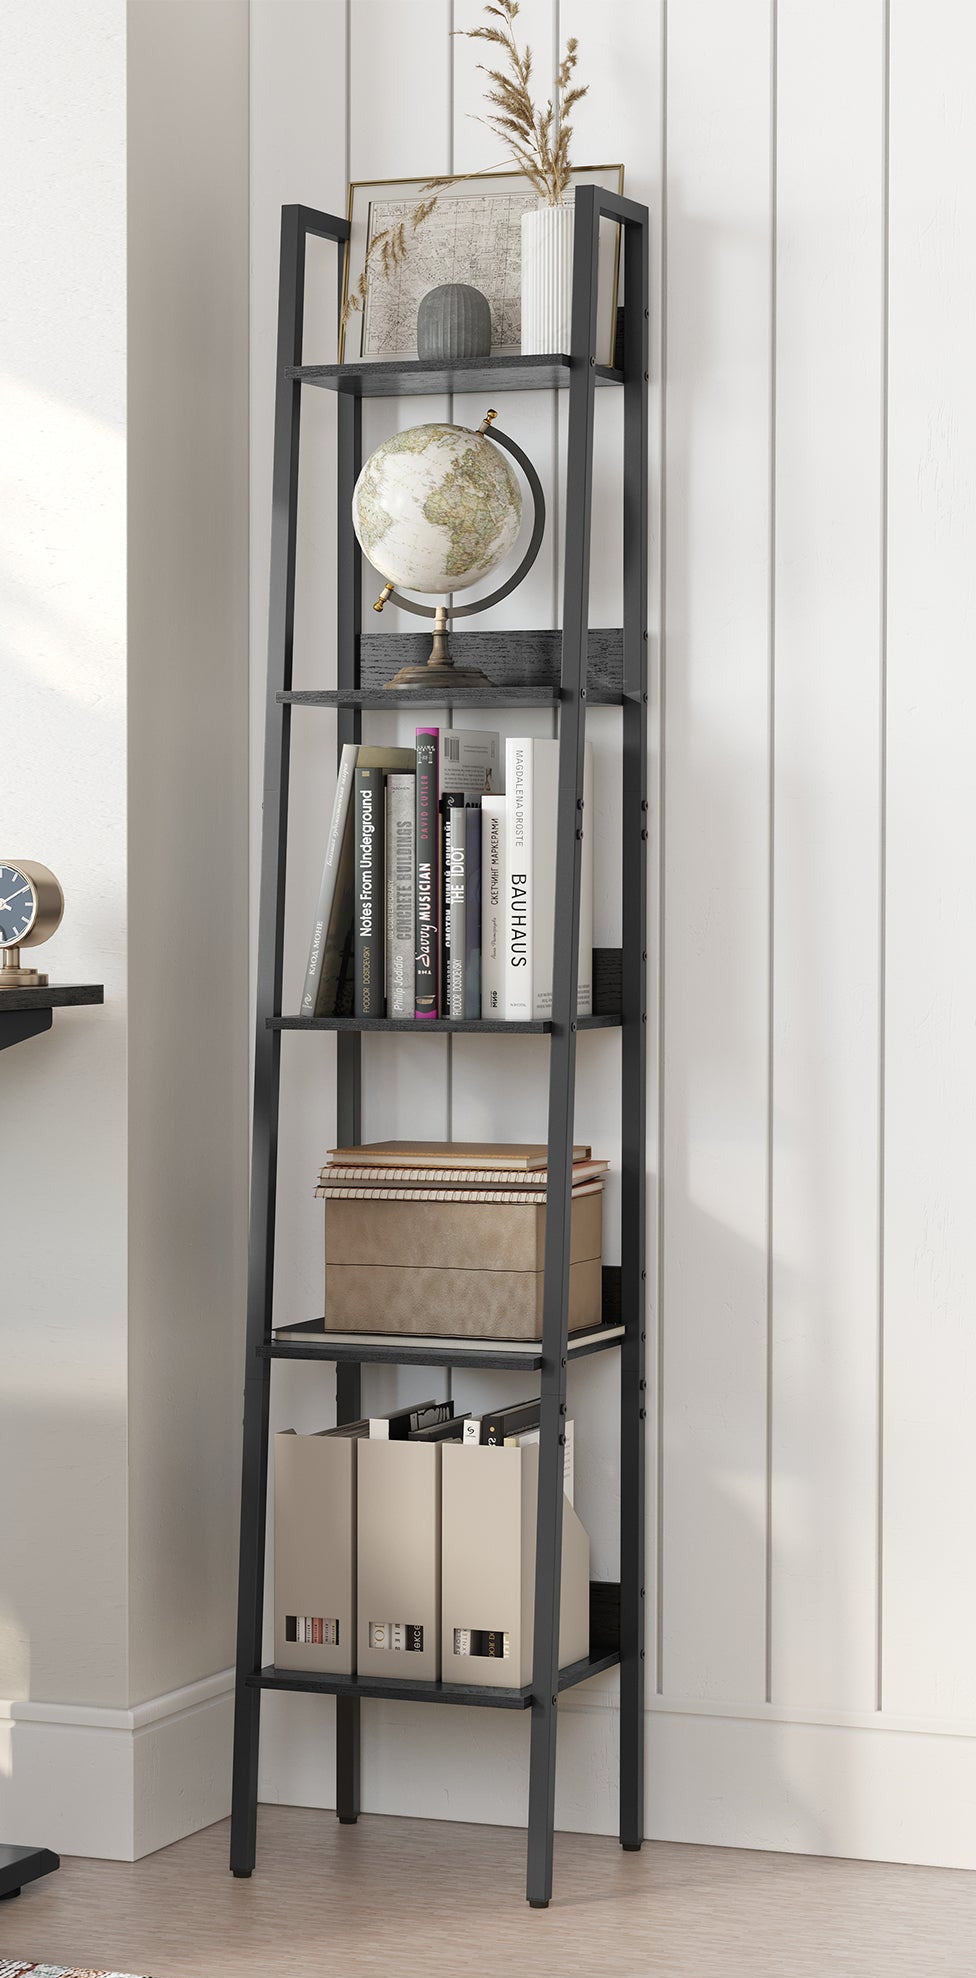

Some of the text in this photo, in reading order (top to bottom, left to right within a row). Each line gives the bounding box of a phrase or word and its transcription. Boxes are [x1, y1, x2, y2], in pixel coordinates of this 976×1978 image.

[420, 775, 429, 839] DAVID CUTLER
[515, 749, 523, 847] MAGDALENA DROSTE
[360, 790, 375, 937] Notes From Underground
[396, 821, 412, 940] CONCRETE BUILDINGS
[419, 862, 431, 921] MUSICIAN
[451, 846, 464, 904] THE IDIOT
[490, 818, 499, 905] СКЕТЧИНГ МАРКЕРАМИ
[312, 920, 324, 949] МОНЕ
[415, 924, 438, 968] Savvy
[511, 874, 527, 967] BAUHAUS
[393, 955, 406, 1011] Philip Jodidio
